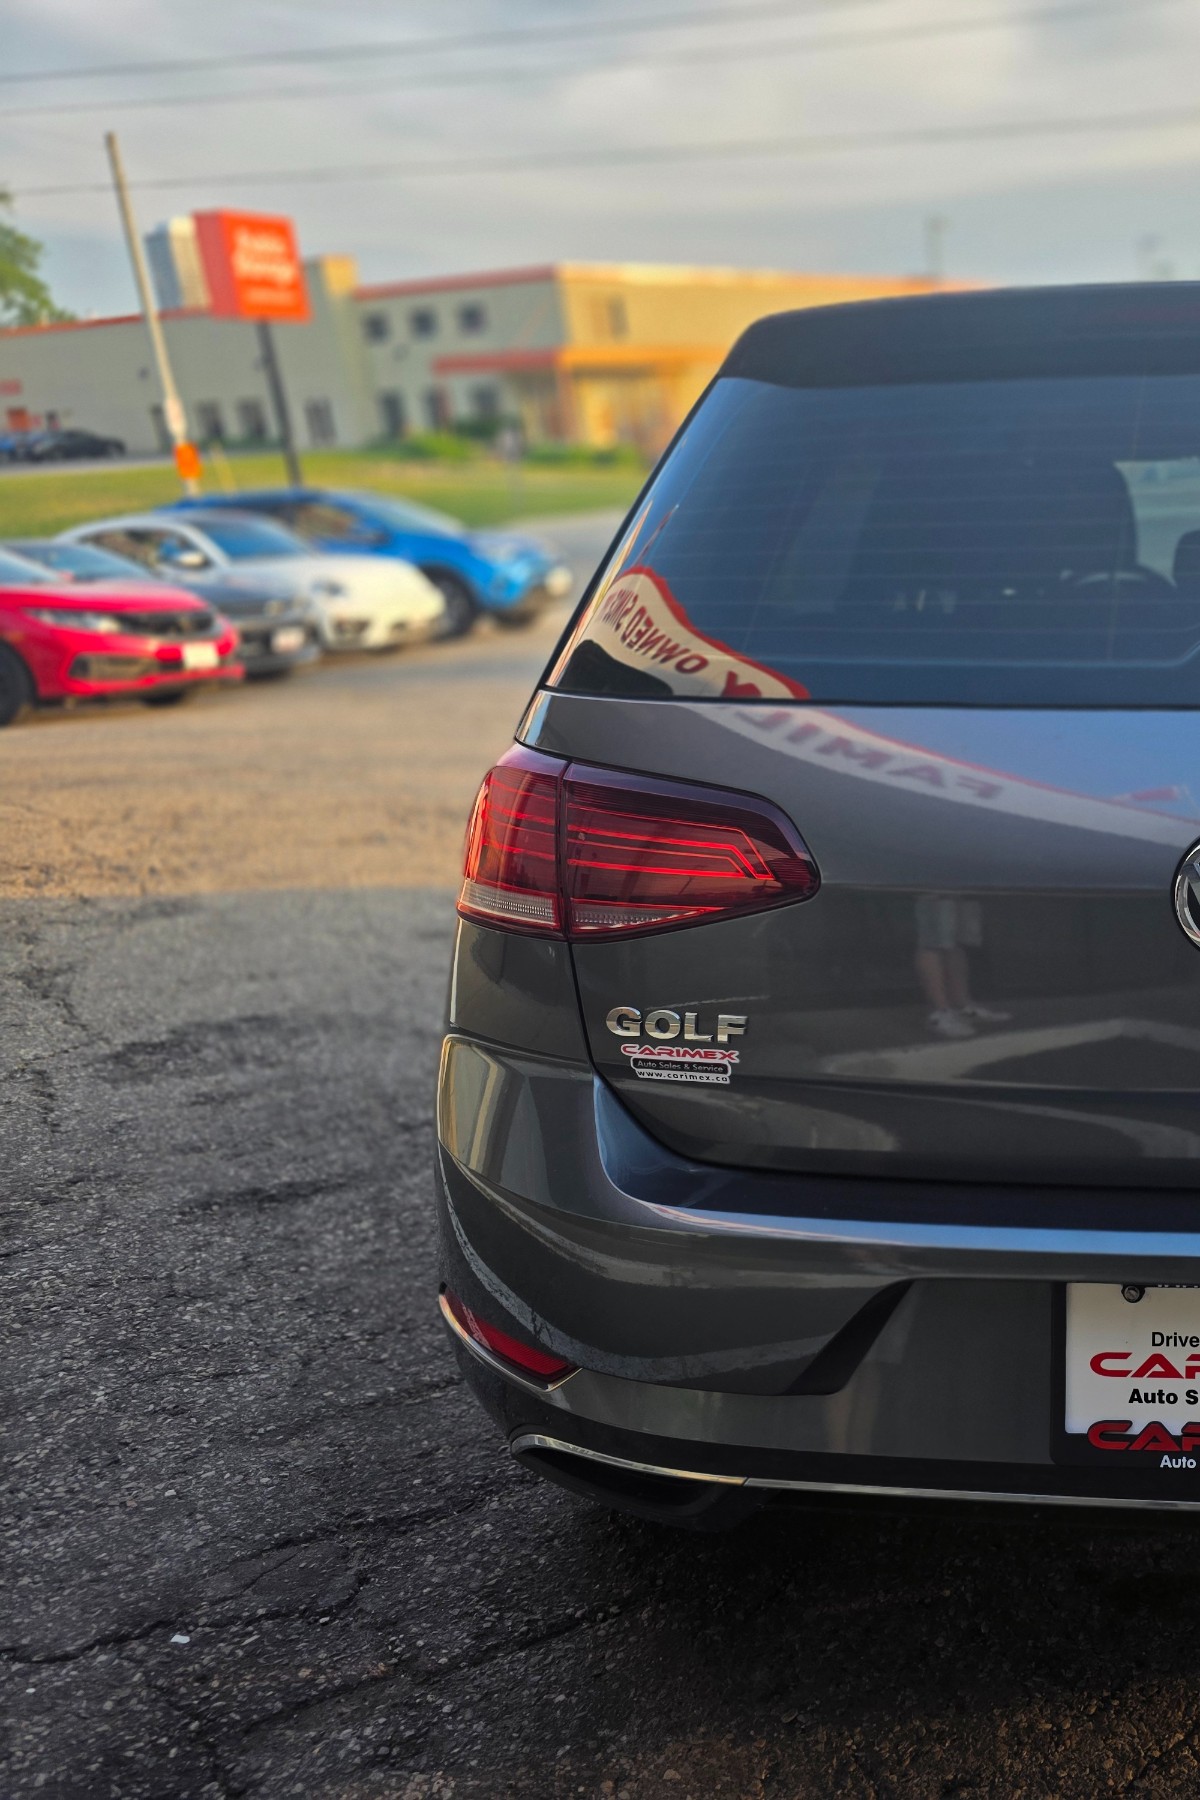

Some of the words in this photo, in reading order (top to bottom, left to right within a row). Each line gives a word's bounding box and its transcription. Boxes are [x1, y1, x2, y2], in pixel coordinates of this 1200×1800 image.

[605, 1006, 748, 1044] GOLF
[621, 1045, 738, 1062] CARIMEX
[637, 1060, 657, 1068] Auto
[659, 1061, 681, 1070] Sales
[693, 1063, 724, 1073] Service
[637, 1070, 729, 1083] www.carimex.ca
[1151, 1331, 1200, 1348] Drive
[1128, 1388, 1179, 1405] Auto
[1159, 1454, 1197, 1469] Auto
